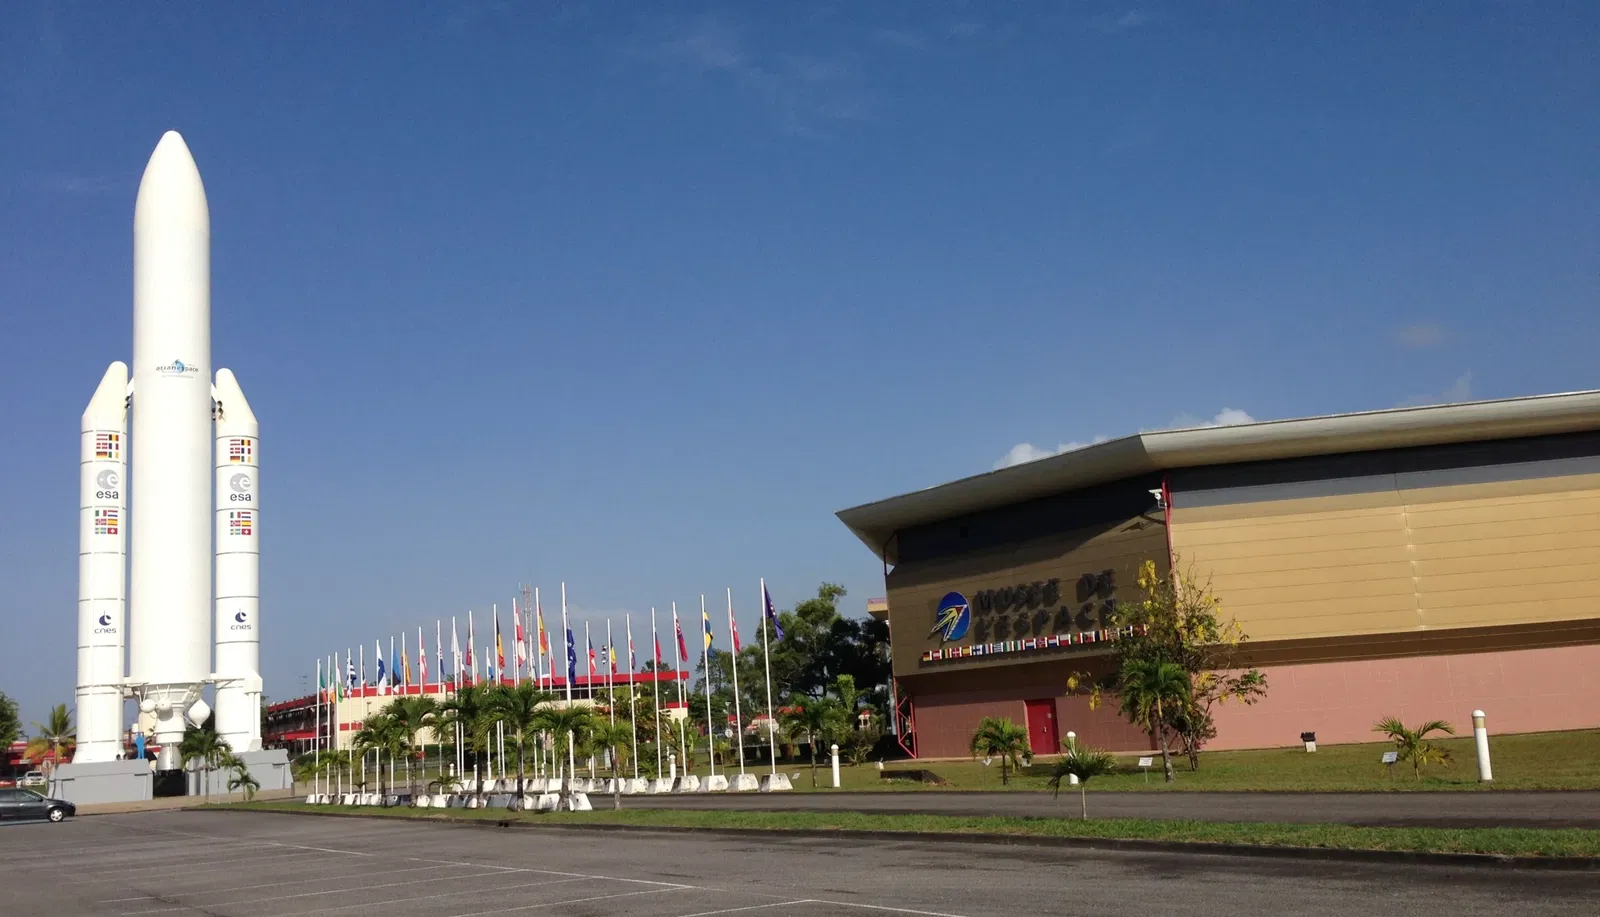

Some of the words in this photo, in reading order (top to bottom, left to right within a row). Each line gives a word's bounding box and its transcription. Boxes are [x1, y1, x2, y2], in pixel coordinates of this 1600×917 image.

[96, 490, 119, 499] esa
[230, 493, 252, 502] esa
[1076, 568, 1117, 602] DE
